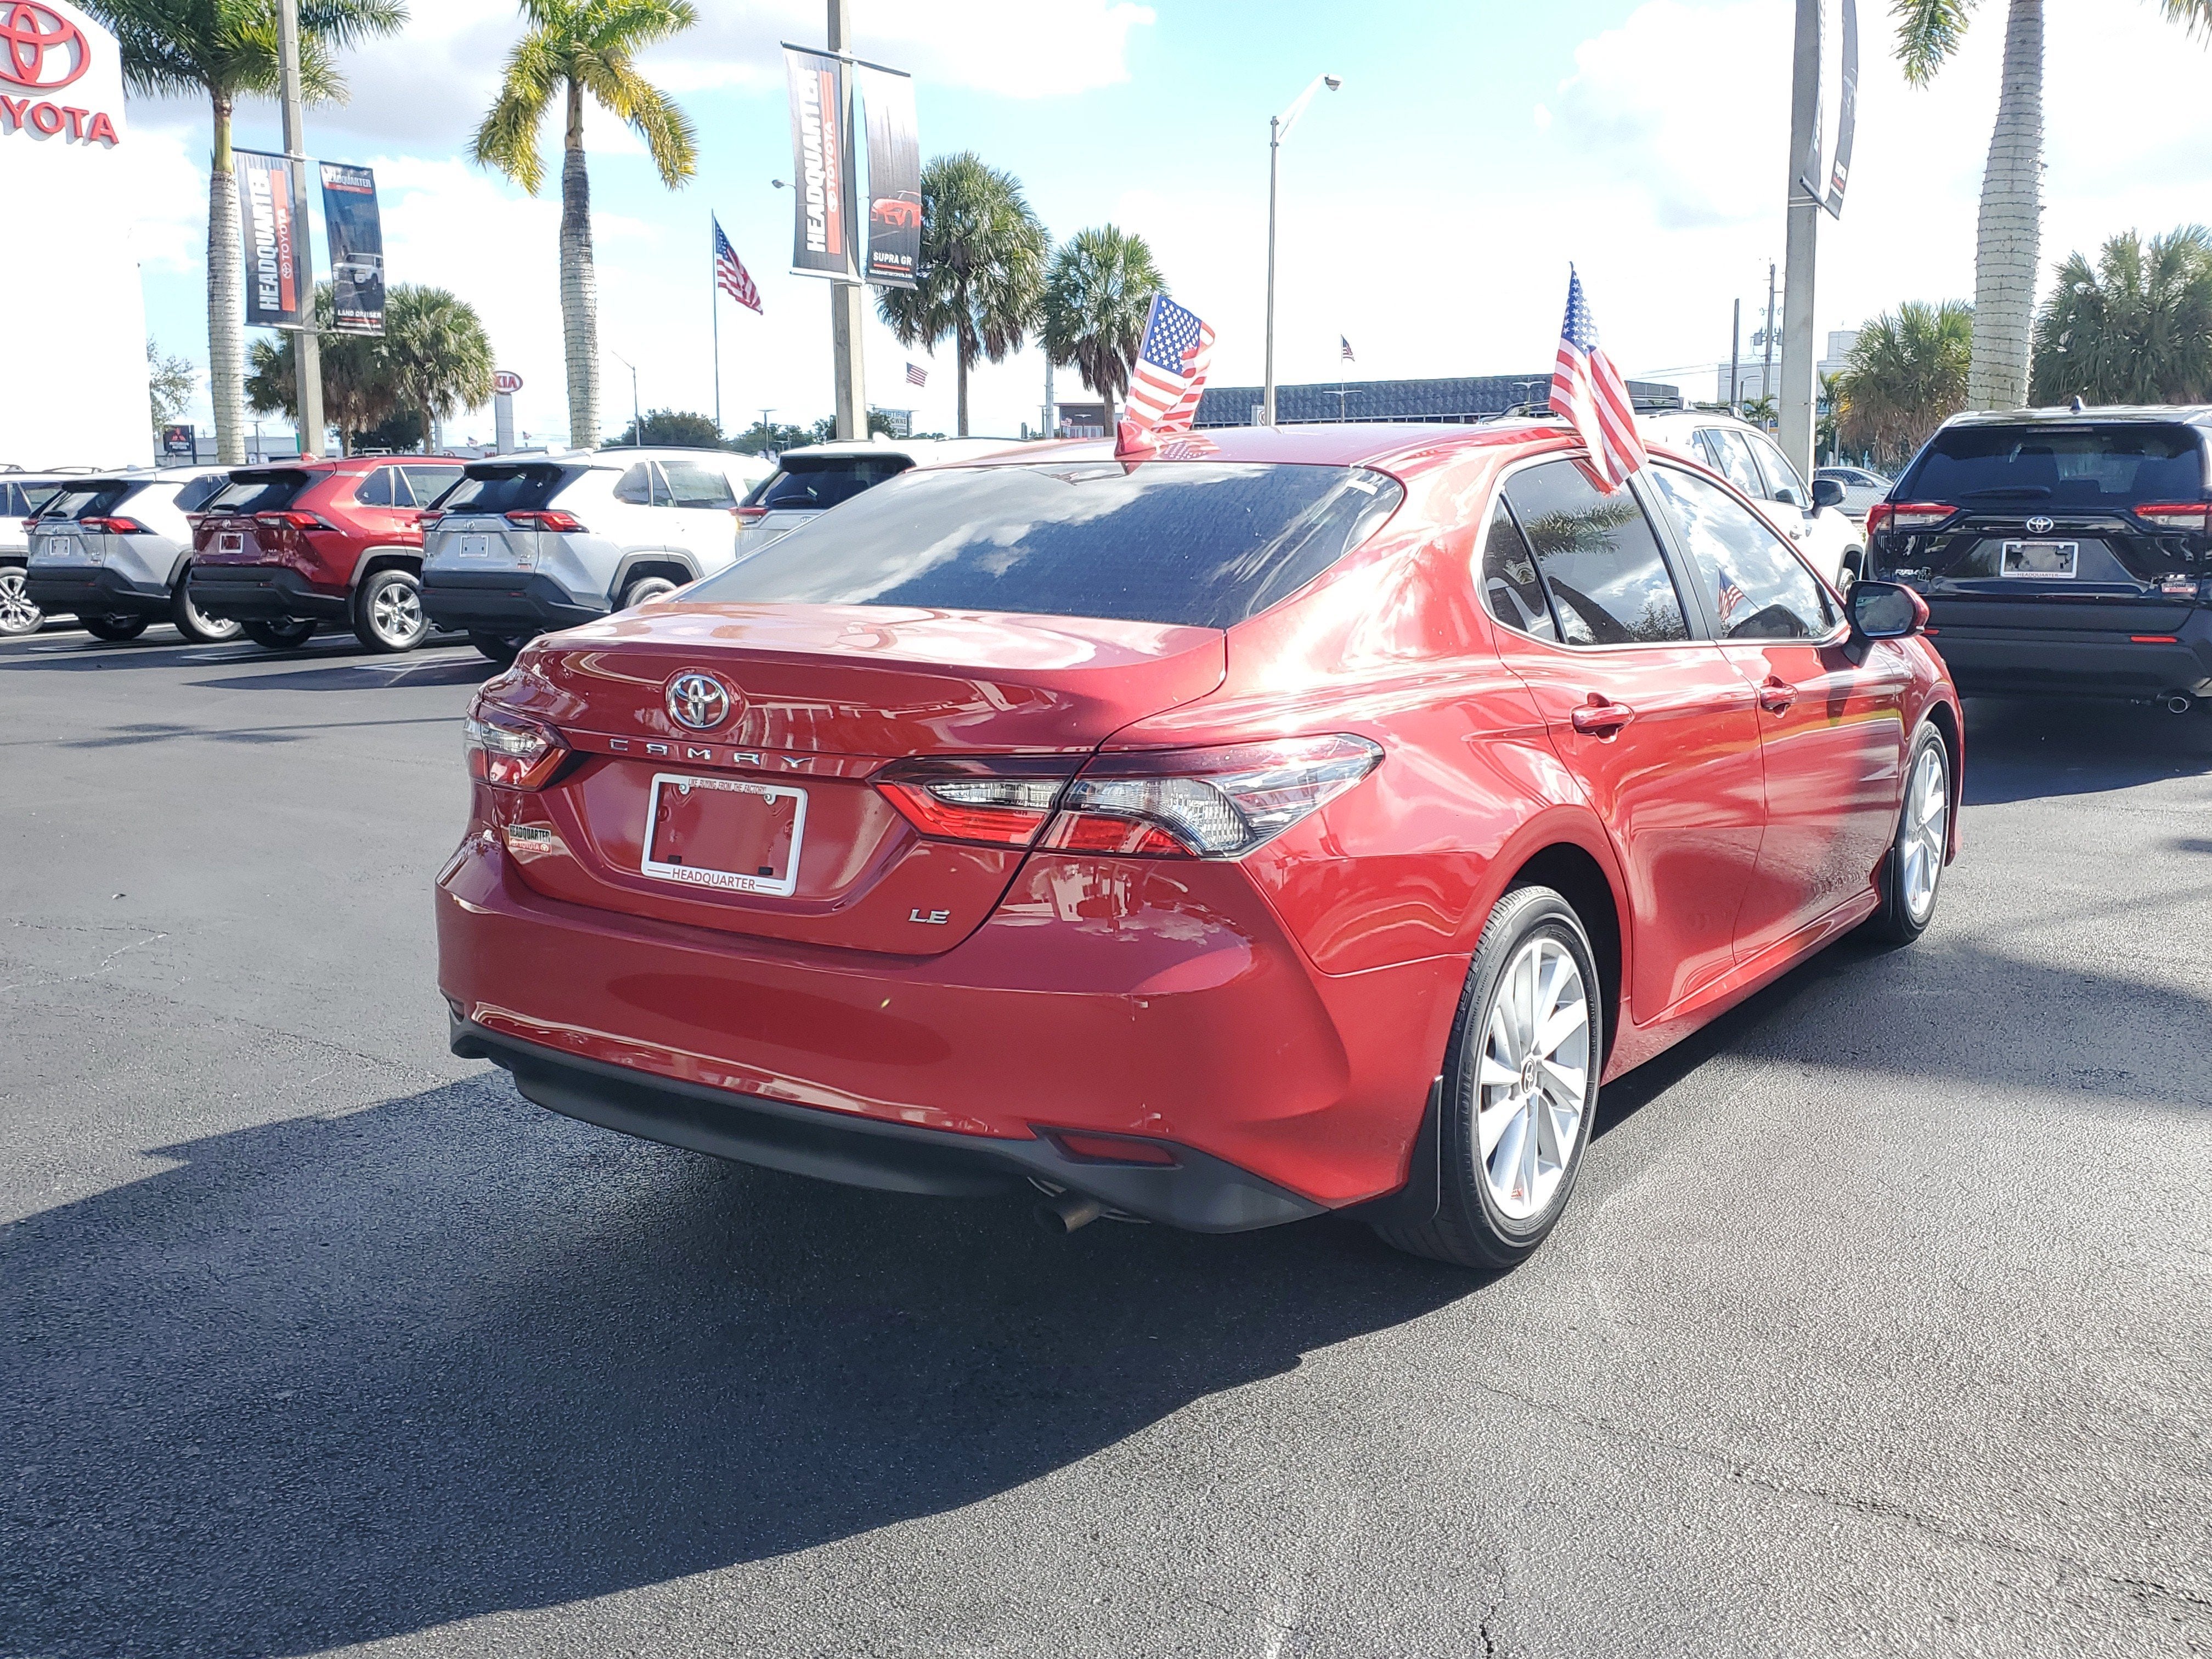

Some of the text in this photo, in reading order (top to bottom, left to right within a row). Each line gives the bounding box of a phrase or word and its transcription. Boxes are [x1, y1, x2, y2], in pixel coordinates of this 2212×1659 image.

[0, 95, 119, 145] YOTA
[824, 121, 836, 190] TOYOTA
[278, 207, 291, 260] TOYOTA
[873, 252, 912, 266] SUPRA GR
[609, 738, 812, 768] CAMRY
[688, 778, 698, 787] LIKE
[699, 779, 716, 789] BUYING
[718, 781, 732, 791] FROM
[733, 783, 743, 793] THE
[509, 825, 551, 843] HEADQUARTER
[519, 842, 540, 851] TOYOTA
[672, 868, 756, 890] HEADQUARTER
[908, 909, 950, 924] LE
